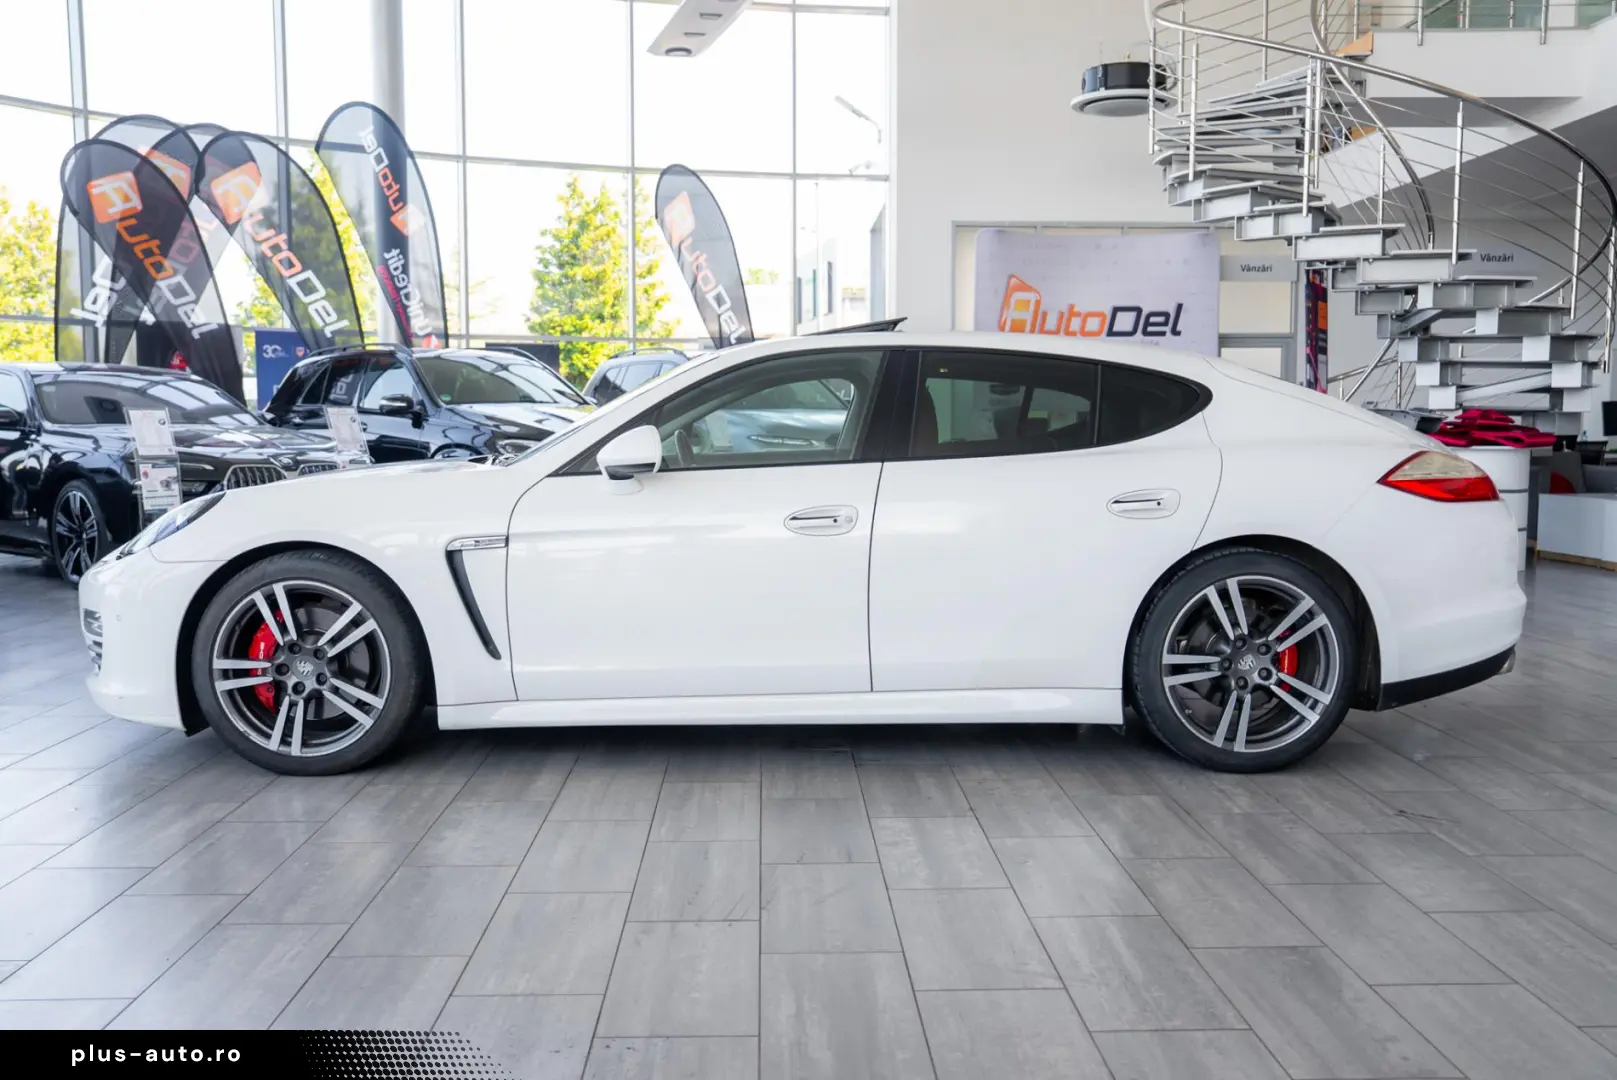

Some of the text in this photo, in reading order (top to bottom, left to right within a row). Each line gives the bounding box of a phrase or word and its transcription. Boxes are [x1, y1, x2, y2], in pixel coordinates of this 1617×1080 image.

[87, 170, 219, 340] AutoDel
[210, 161, 350, 338] AutoDel
[1239, 263, 1273, 274] Vânzări
[1479, 252, 1514, 263] Vânzări
[998, 273, 1184, 338] AutoDel
